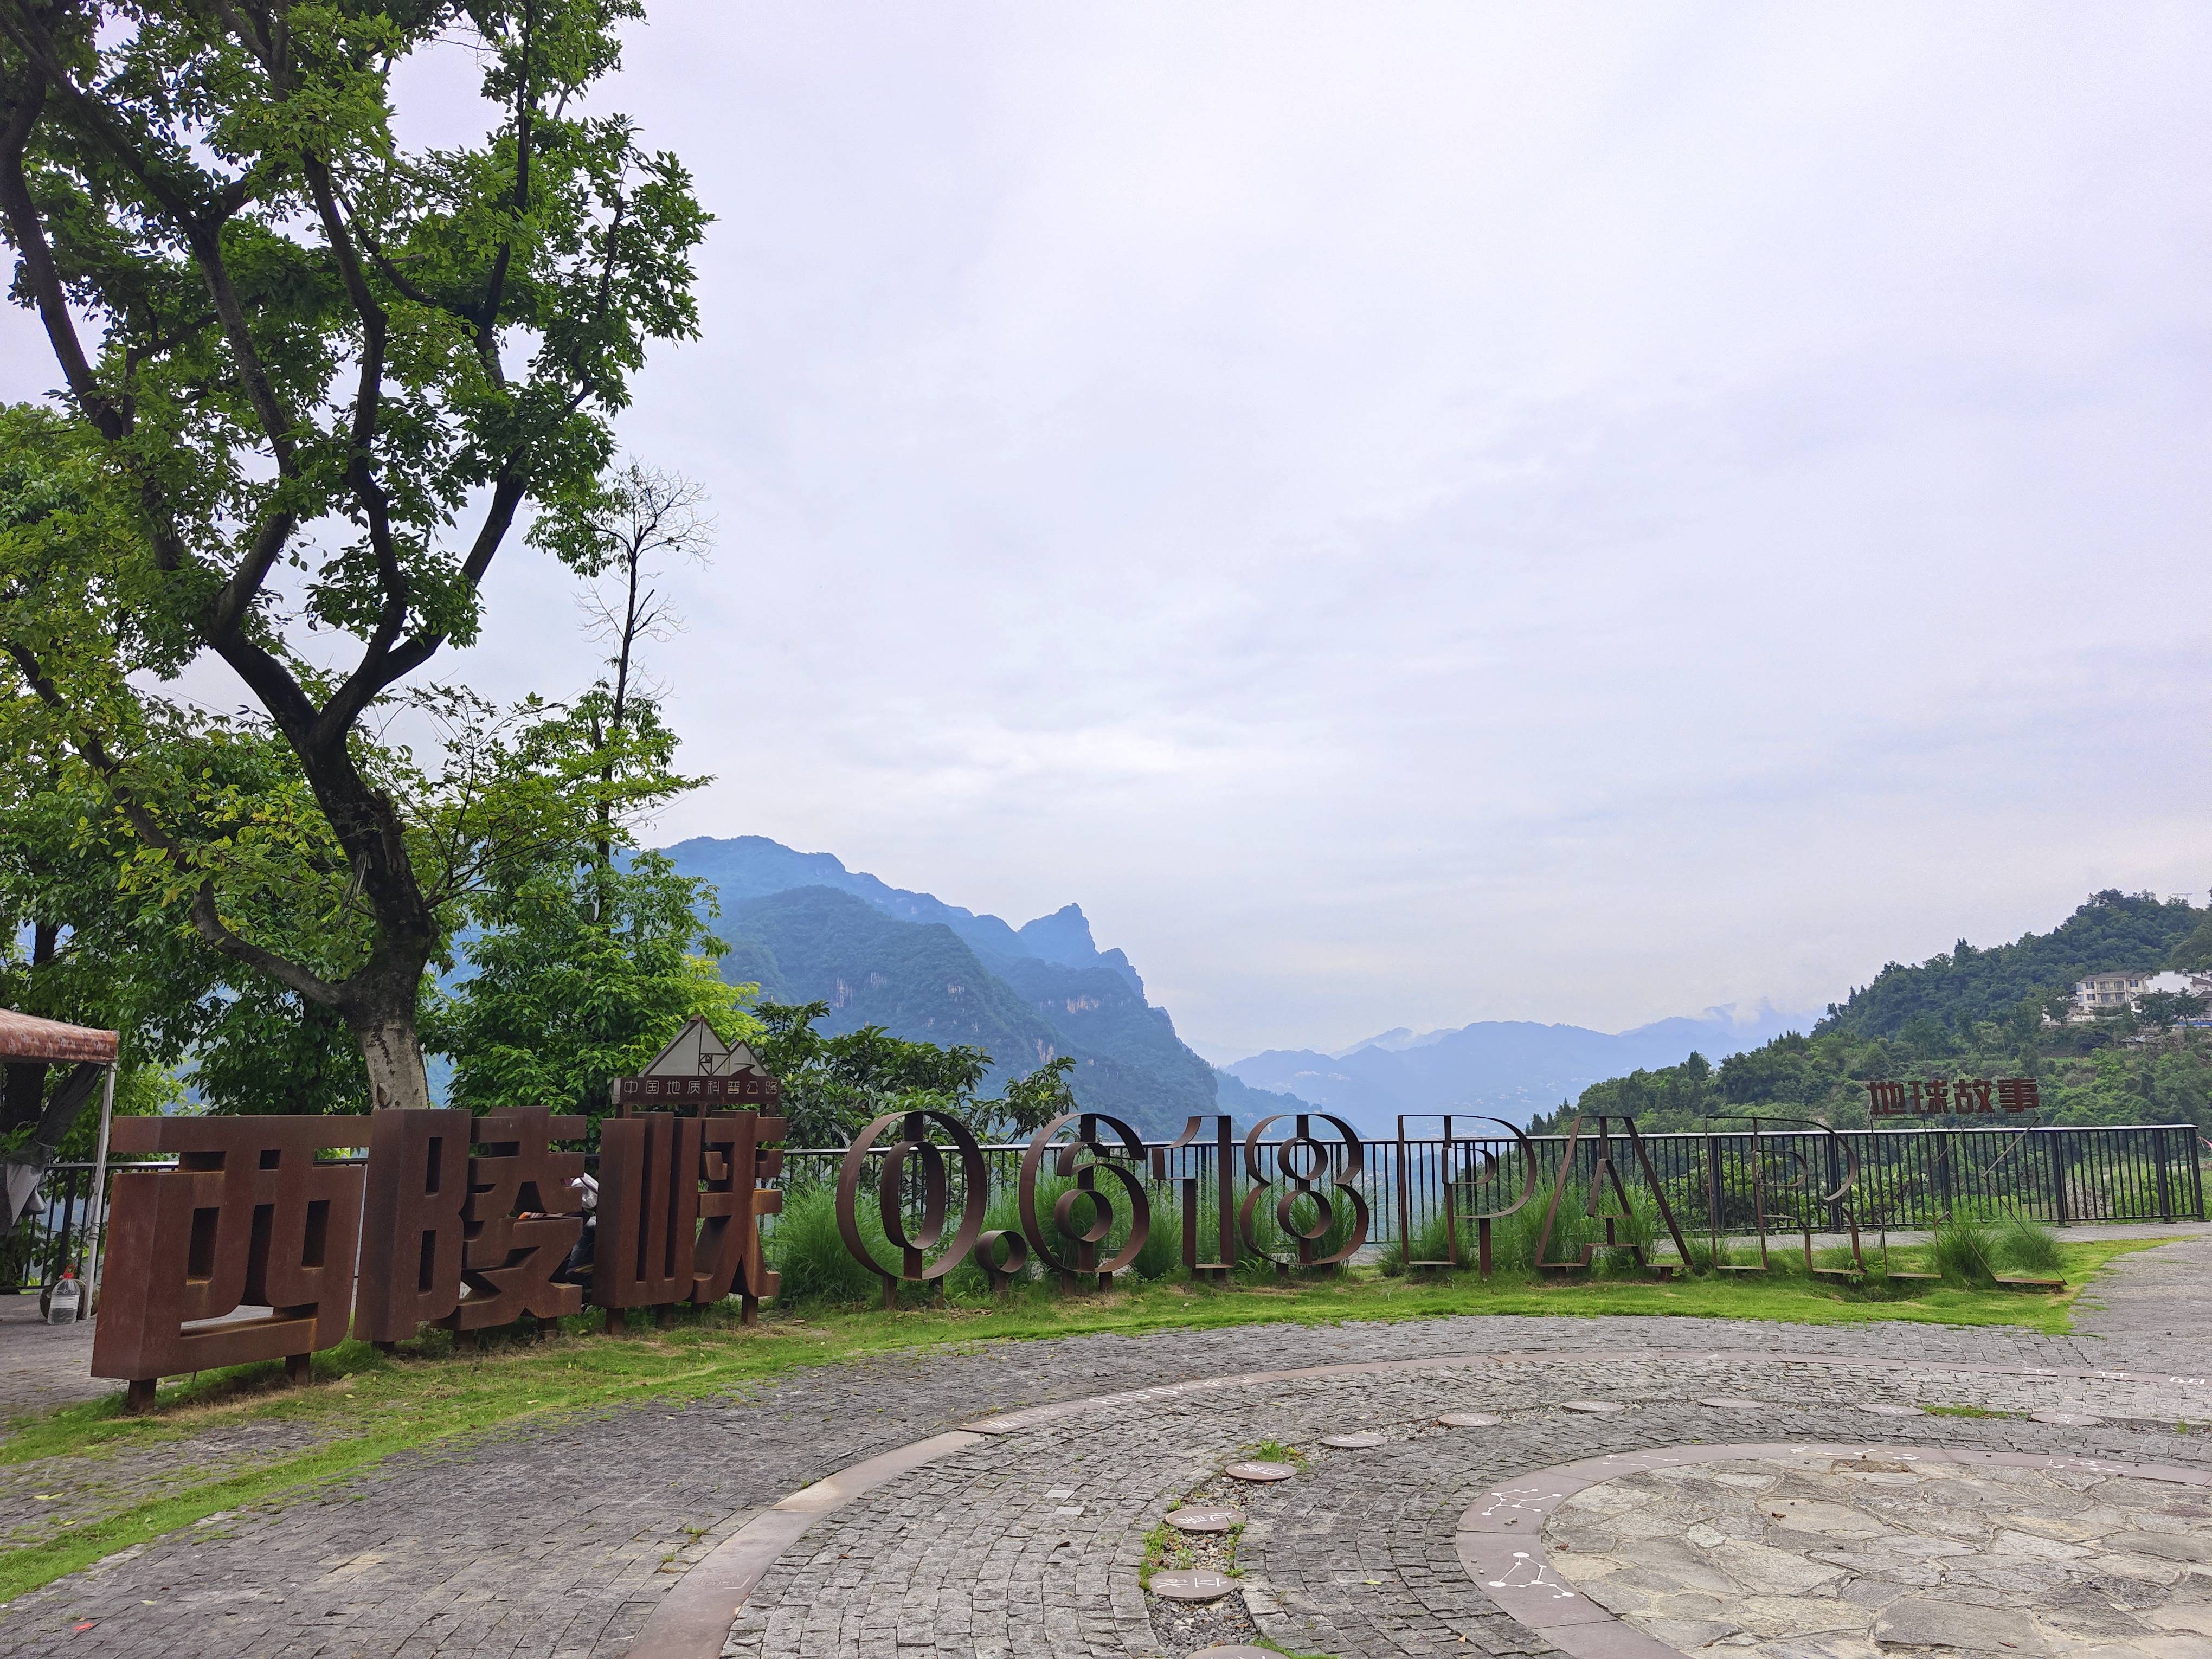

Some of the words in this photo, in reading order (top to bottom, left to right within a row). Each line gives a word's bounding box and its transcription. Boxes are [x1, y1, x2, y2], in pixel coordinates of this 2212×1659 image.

[623, 1079, 778, 1095] 中国地质科普公路
[1867, 1078, 2040, 1114] 地球故事
[91, 1105, 787, 1380] 西陵峡
[1154, 1577, 1227, 1589] 立秋
